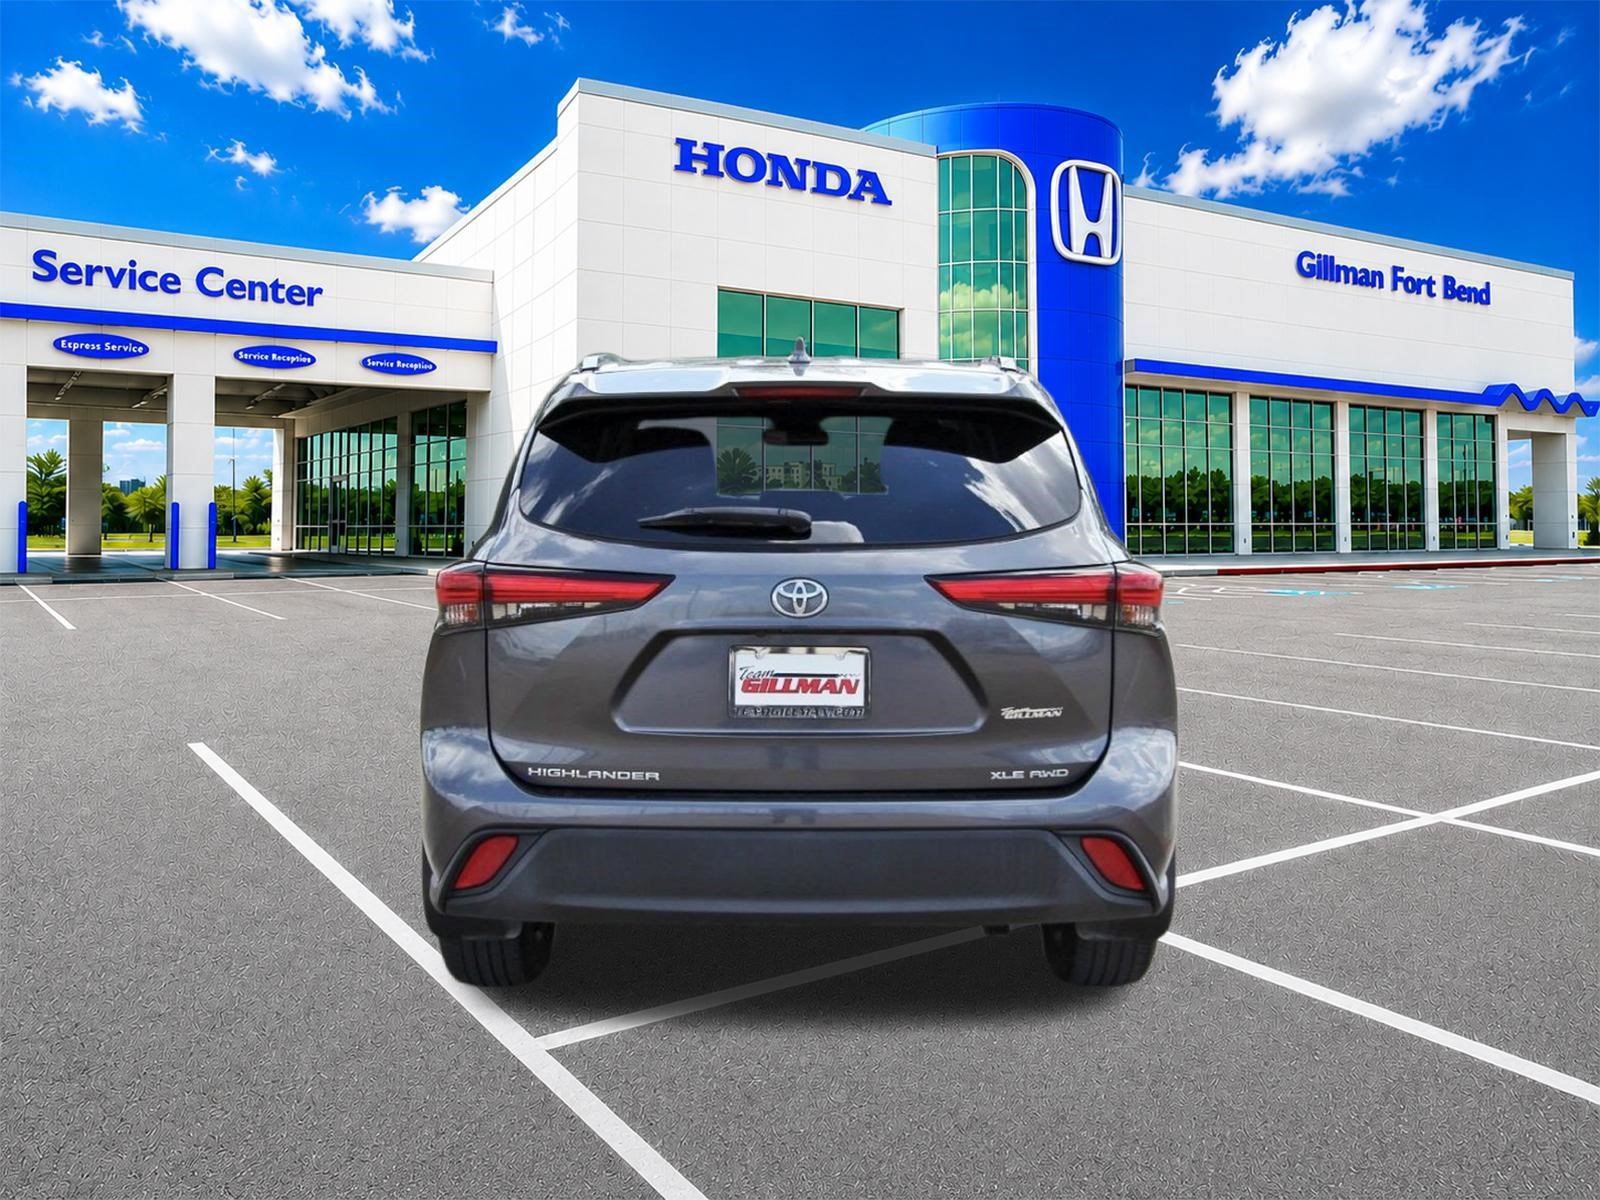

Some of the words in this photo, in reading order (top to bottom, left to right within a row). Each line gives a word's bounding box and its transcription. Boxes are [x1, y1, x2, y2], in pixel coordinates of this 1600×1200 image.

[674, 137, 892, 206] HONDA
[32, 249, 182, 294] Service
[195, 266, 323, 307] Center
[1296, 250, 1384, 290] Gillman
[1391, 265, 1436, 298] Fort
[1443, 275, 1491, 306] Bend
[104, 342, 144, 353] Service
[238, 351, 269, 361] Service
[366, 358, 394, 368] Service
[739, 665, 776, 681] Team
[741, 678, 860, 694] GILLMAN
[527, 767, 661, 781] HIGHLANDER
[990, 770, 1025, 780] XLE
[1029, 768, 1070, 779] AWD
